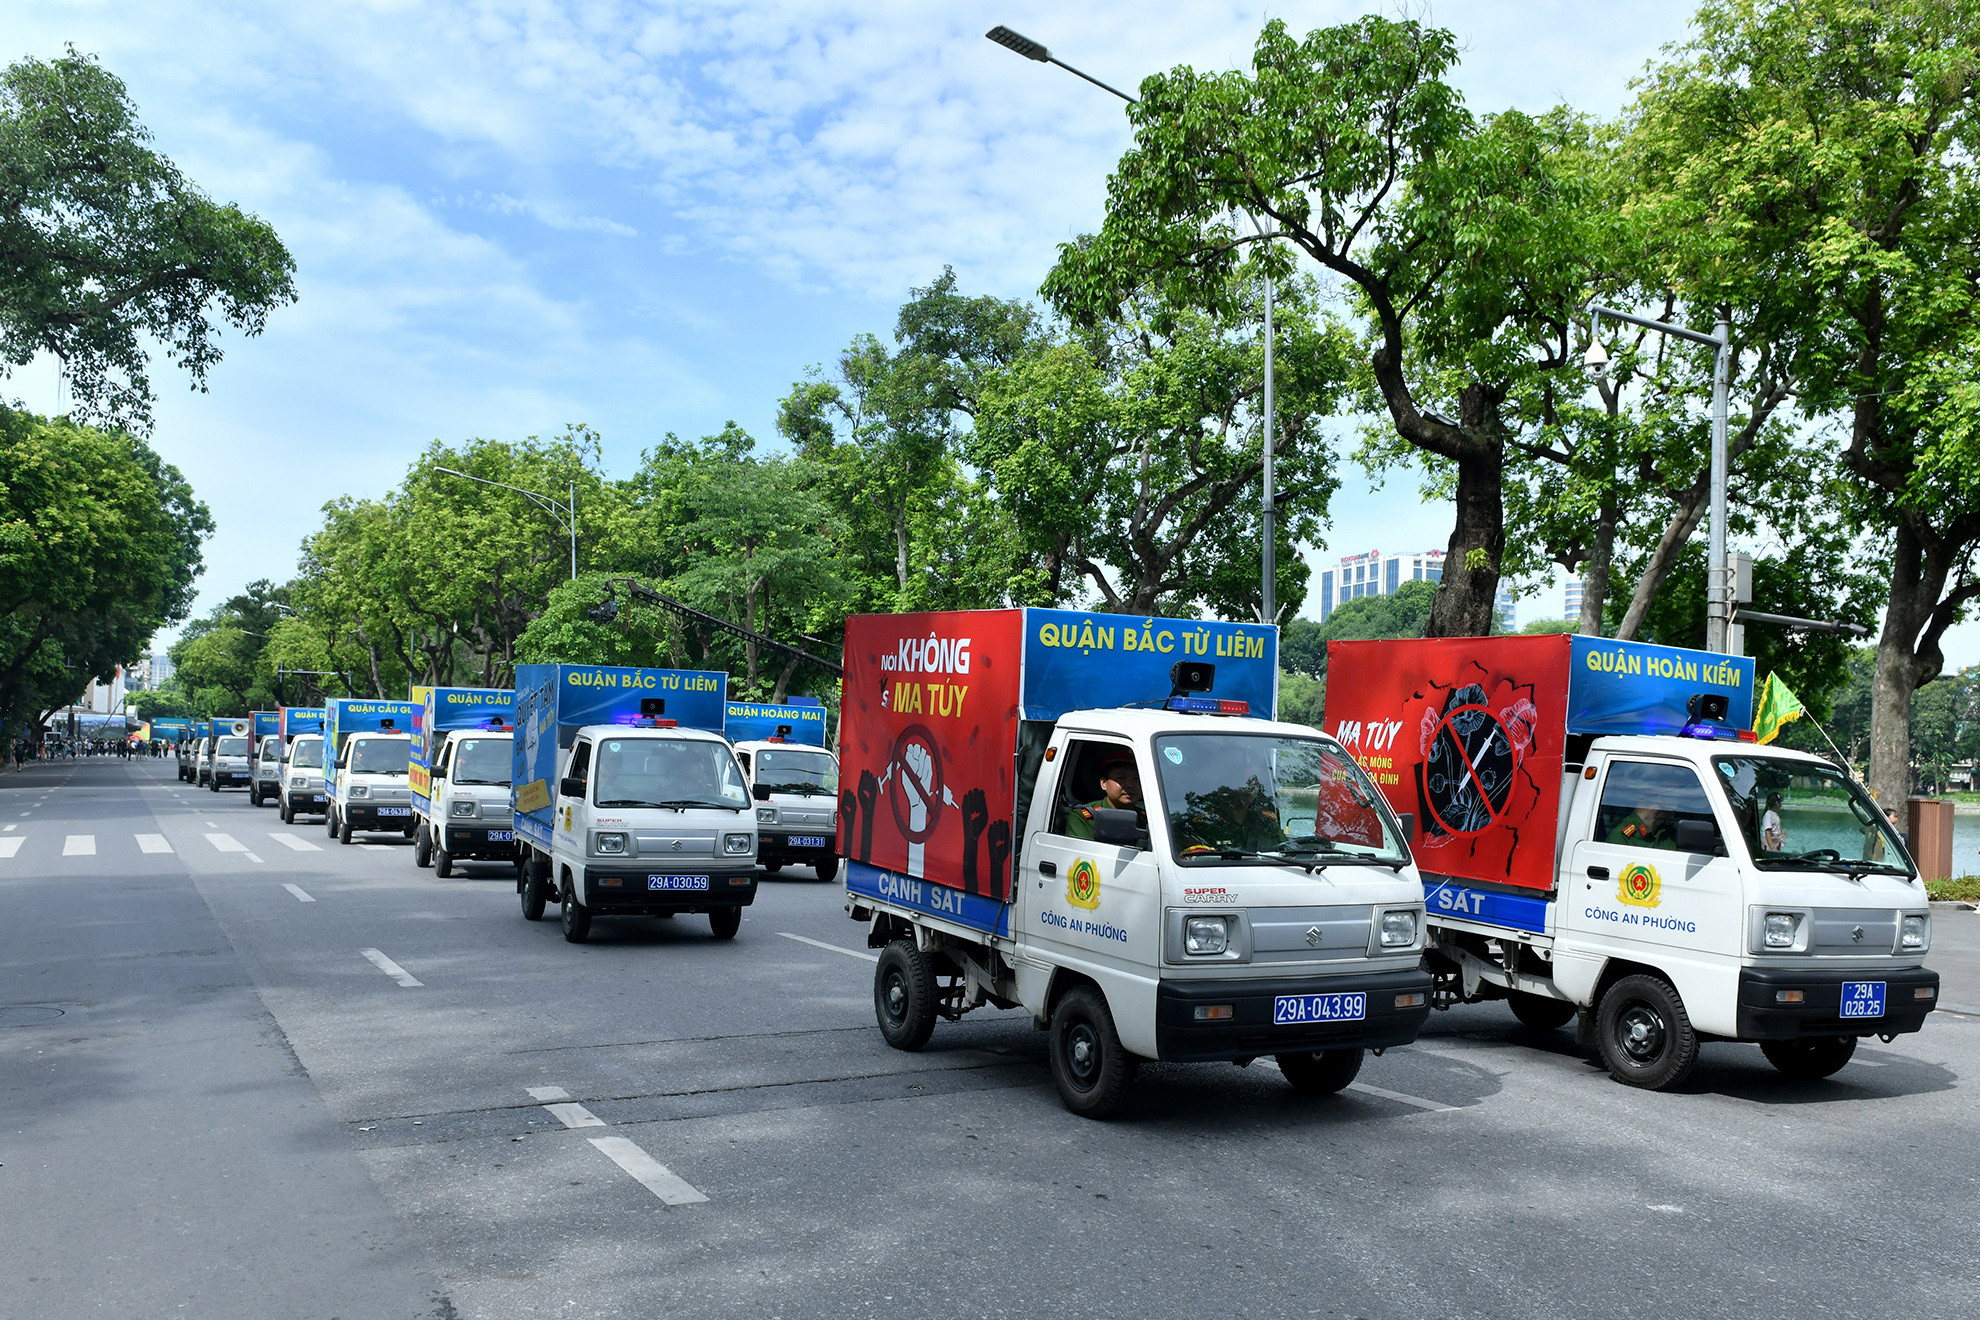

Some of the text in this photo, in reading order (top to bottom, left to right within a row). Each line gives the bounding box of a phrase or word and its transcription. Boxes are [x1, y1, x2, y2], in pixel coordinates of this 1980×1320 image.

[1039, 618, 1264, 659] QUẬN BẮC TỪ LIÊM
[881, 631, 971, 674] NÓI KHÔNG
[1586, 648, 1740, 687] QUẬN HOÀN KIẾM
[568, 669, 718, 692] QUẬN BẮC TỪ LIÊM
[447, 692, 482, 706] QUẬN
[893, 682, 922, 714] MA
[927, 678, 968, 718] TÚY
[294, 710, 317, 720] QUẬN
[348, 704, 375, 714] QUẬN
[400, 706, 412, 714] GI
[728, 706, 820, 720] QUẬN HOÀNG MAI
[1336, 717, 1403, 752] MA TÚY
[1370, 754, 1392, 770] MỘNG
[1380, 771, 1399, 785] ĐÌNH
[650, 877, 707, 889] 29A-030.59
[1184, 887, 1226, 895] SUPER
[1184, 894, 1238, 903] CARRY
[1438, 888, 1485, 915] SÁT
[1041, 910, 1127, 943] CÔNG AN PHƯỜNG
[1585, 907, 1696, 933] CÔNG AN PHƯỜNG
[1854, 984, 1873, 999] 29A
[1277, 996, 1363, 1020] 29A-043.99
[1845, 1000, 1880, 1016] 028.25
